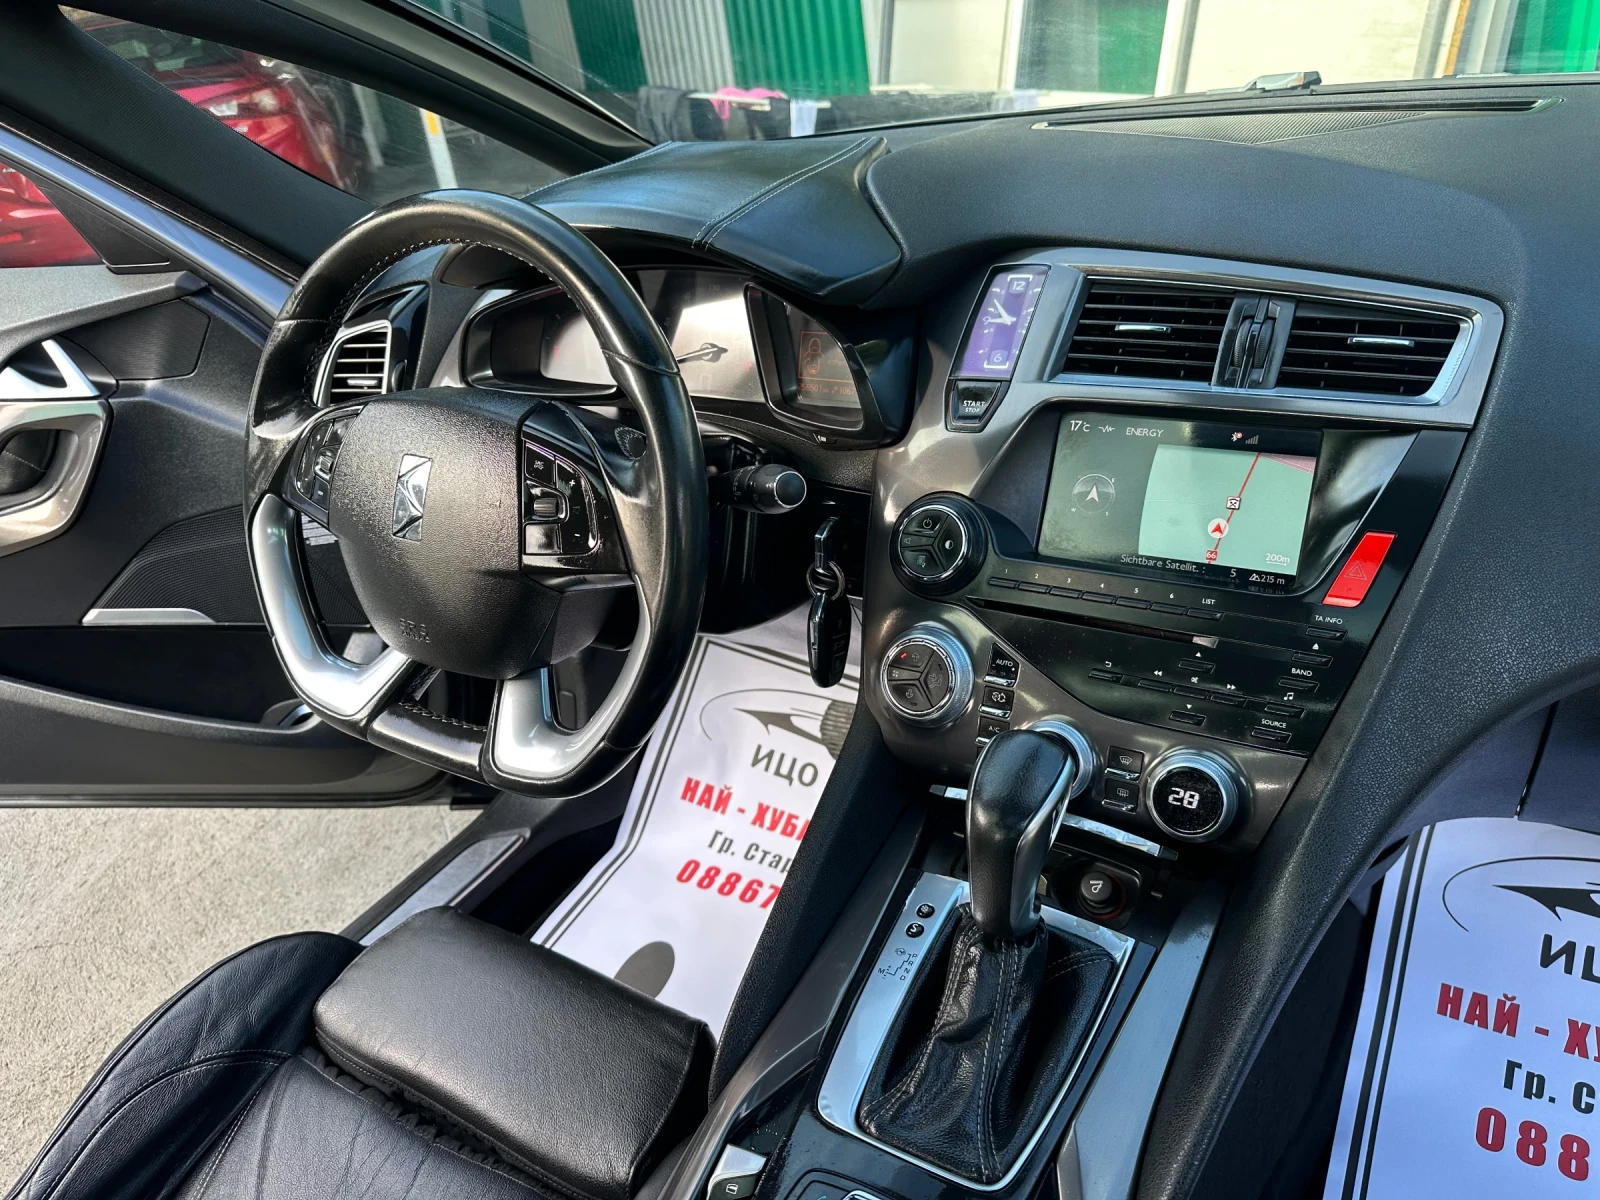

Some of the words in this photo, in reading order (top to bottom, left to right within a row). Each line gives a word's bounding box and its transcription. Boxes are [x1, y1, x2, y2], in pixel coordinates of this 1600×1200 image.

[1012, 281, 1026, 291] 12
[993, 353, 1003, 363] 6
[1125, 427, 1164, 437] ENERGY
[1206, 551, 1217, 560] 66
[1265, 553, 1290, 563] 200m
[1120, 554, 1163, 567] Sichtbare
[1165, 560, 1199, 573] Satellit.
[1230, 569, 1237, 577] 5
[1260, 574, 1275, 584] 215
[1202, 598, 1216, 606] LIST
[1314, 615, 1323, 623] TA
[1324, 616, 1343, 625] INFO
[996, 659, 1013, 667] AUTO
[1291, 668, 1313, 677] BAND
[1261, 718, 1287, 729] SOURCE
[750, 743, 819, 787] ИЦО
[680, 776, 733, 816] НАЙ
[1168, 787, 1200, 809] 28
[707, 829, 736, 856] Гр.
[675, 858, 782, 910] 08867
[910, 923, 919, 932] S
[1436, 982, 1520, 1037] НАЙ
[1503, 1059, 1556, 1104] Гр.
[1475, 1106, 1591, 1182] 088
